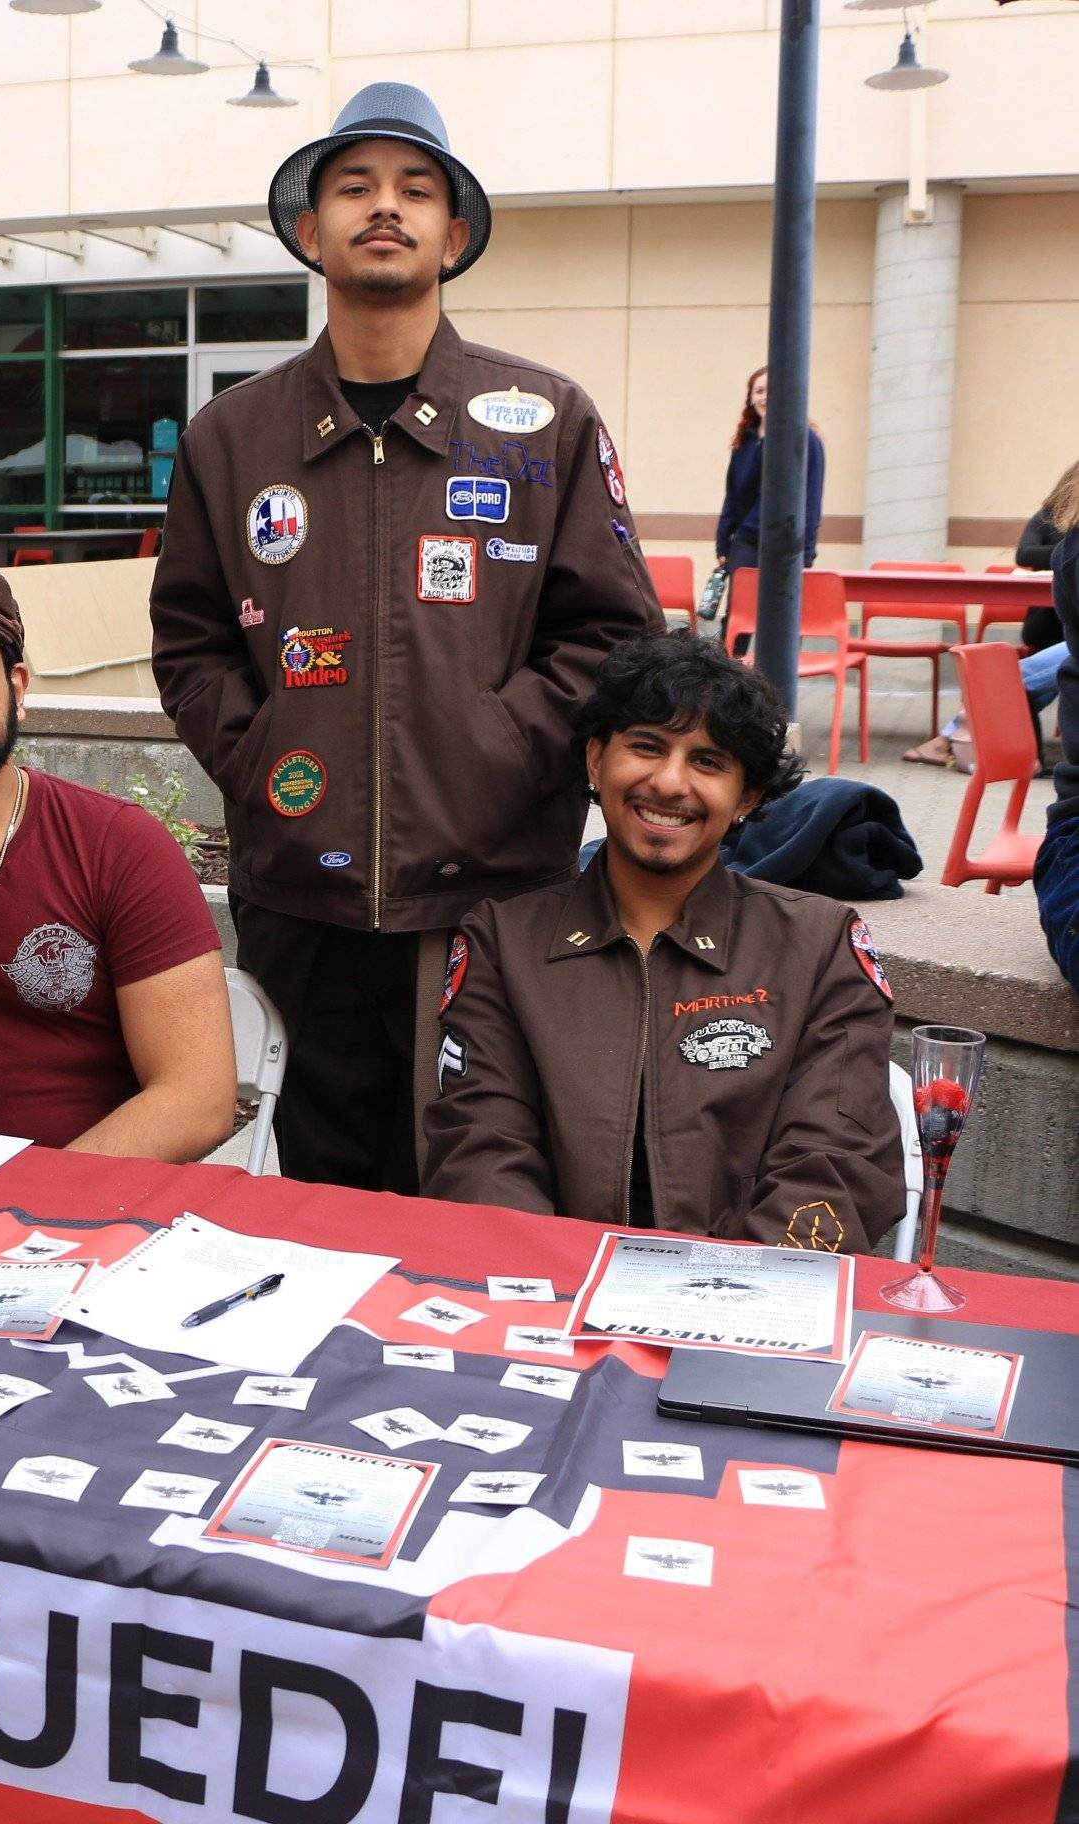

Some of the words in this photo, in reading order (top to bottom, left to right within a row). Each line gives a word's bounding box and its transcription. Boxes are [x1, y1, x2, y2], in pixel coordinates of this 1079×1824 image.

[485, 410, 538, 426] LIGHT
[268, 489, 296, 501] JACINTO
[476, 493, 501, 505] FORD
[265, 544, 296, 560] HISTORIC
[423, 590, 445, 599] TACOS
[296, 627, 333, 638] HOUSTON
[284, 665, 349, 689] Rodeo
[273, 755, 319, 779] PALLETIZED
[272, 790, 311, 813] TRUCKING
[734, 1335, 808, 1351] Join
[287, 1444, 333, 1458] Join
